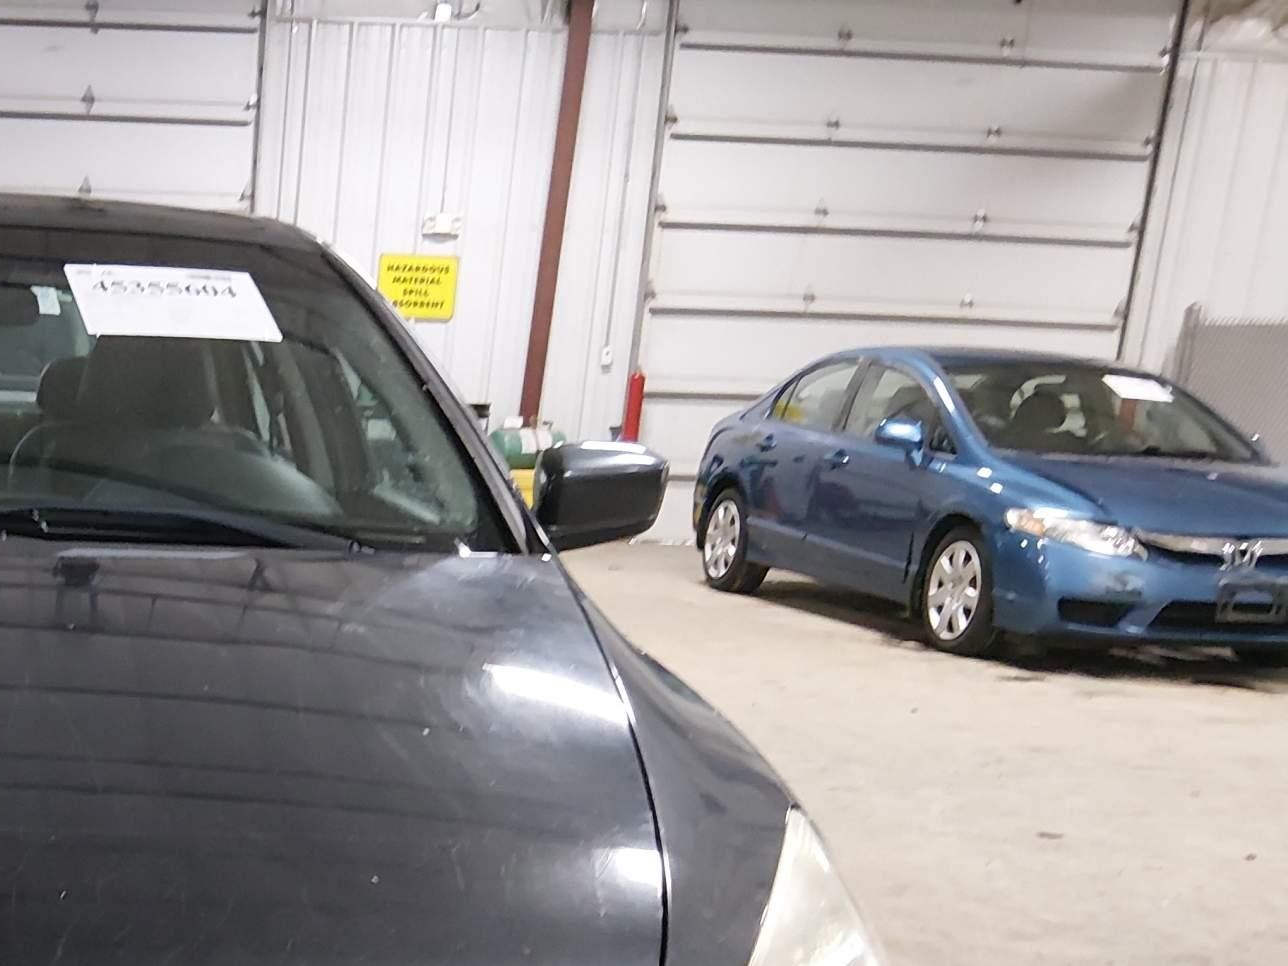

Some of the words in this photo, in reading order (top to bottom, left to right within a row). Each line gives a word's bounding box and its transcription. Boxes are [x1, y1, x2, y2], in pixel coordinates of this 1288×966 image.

[387, 264, 450, 274] HAZARDOUS
[392, 276, 442, 285] MATERIAL
[92, 279, 237, 298] 45355604
[403, 288, 429, 297] SPILL
[392, 299, 445, 309] BSORBENT
